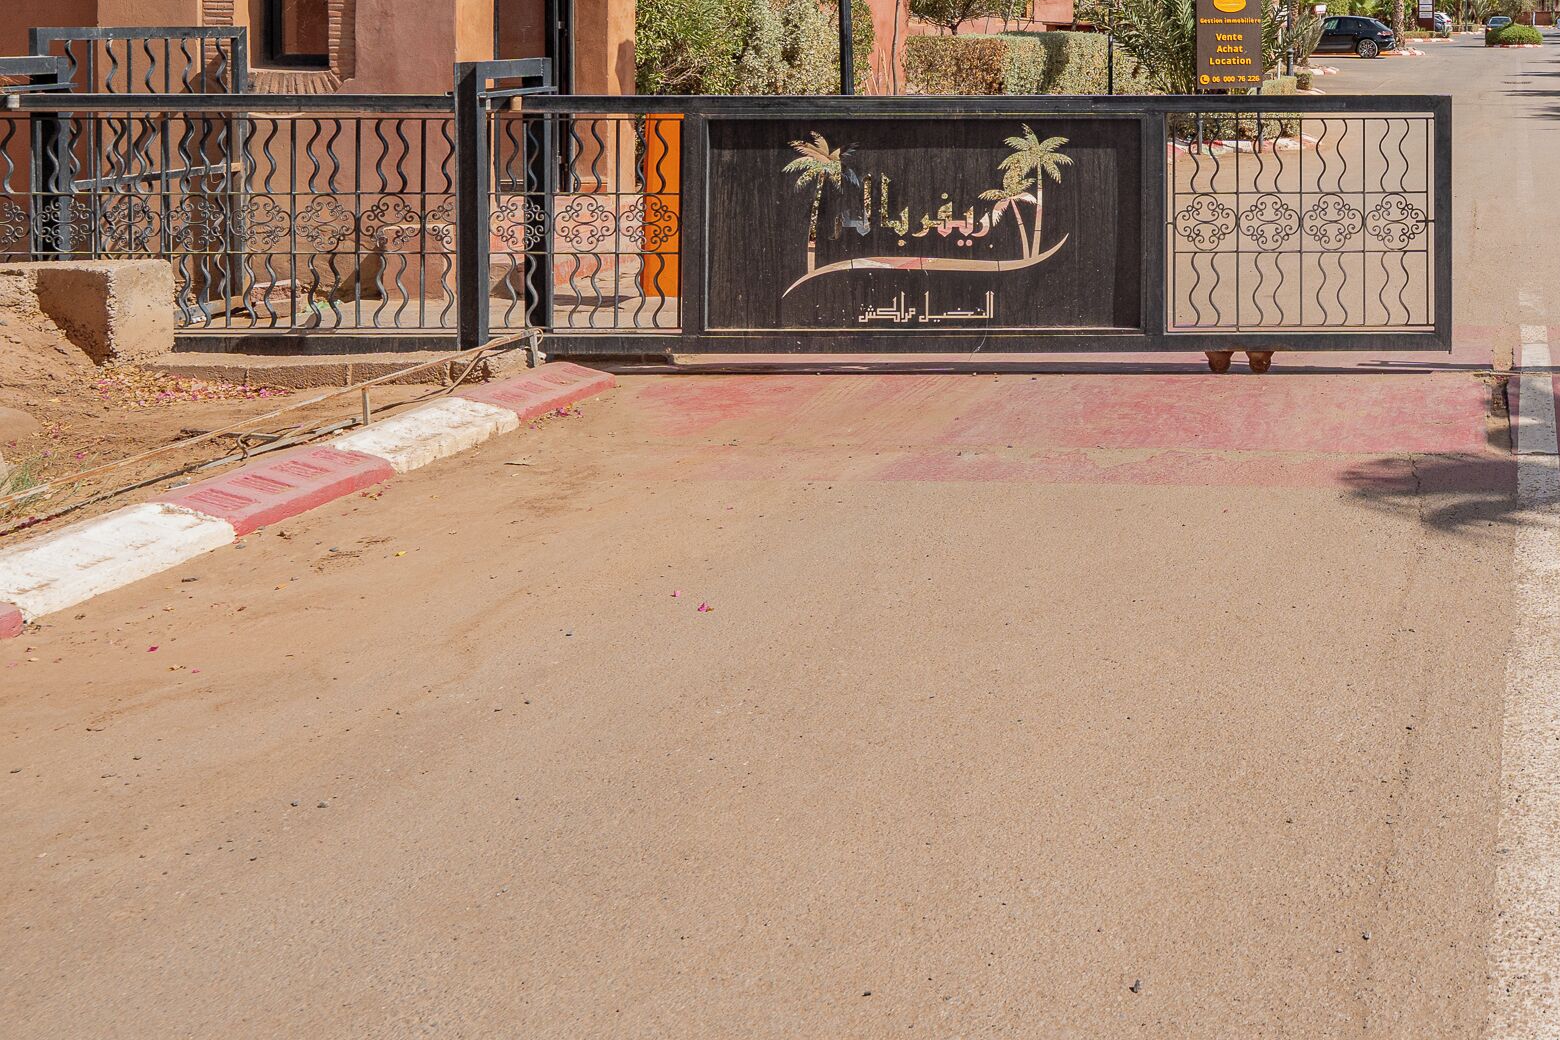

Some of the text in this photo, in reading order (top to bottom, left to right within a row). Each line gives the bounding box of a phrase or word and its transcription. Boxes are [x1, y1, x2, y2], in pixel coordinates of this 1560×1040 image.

[1215, 33, 1243, 41] Vente
[1216, 45, 1243, 53] Achat
[1209, 57, 1252, 65] Location
